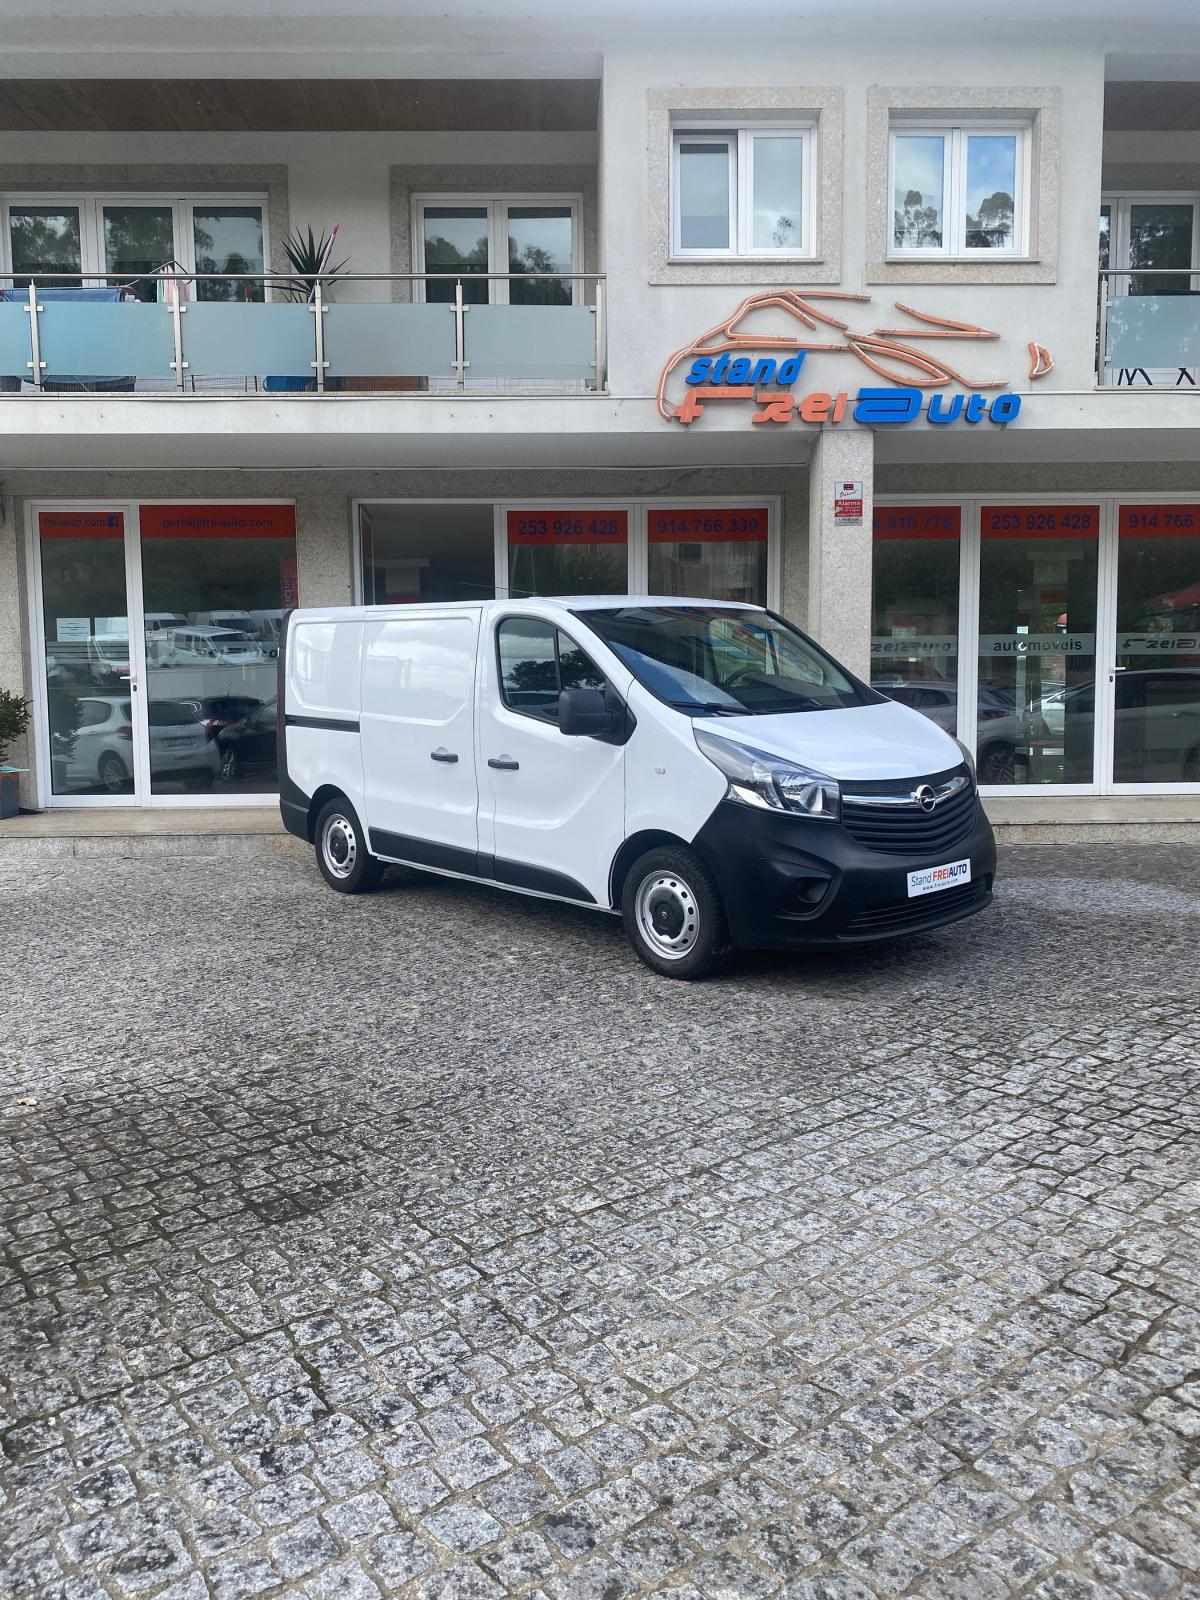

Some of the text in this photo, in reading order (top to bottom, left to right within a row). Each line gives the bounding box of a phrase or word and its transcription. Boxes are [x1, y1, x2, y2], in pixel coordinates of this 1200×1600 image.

[685, 350, 807, 386] stand
[911, 873, 932, 887] Stand
[932, 863, 967, 880] FREIAUTO
